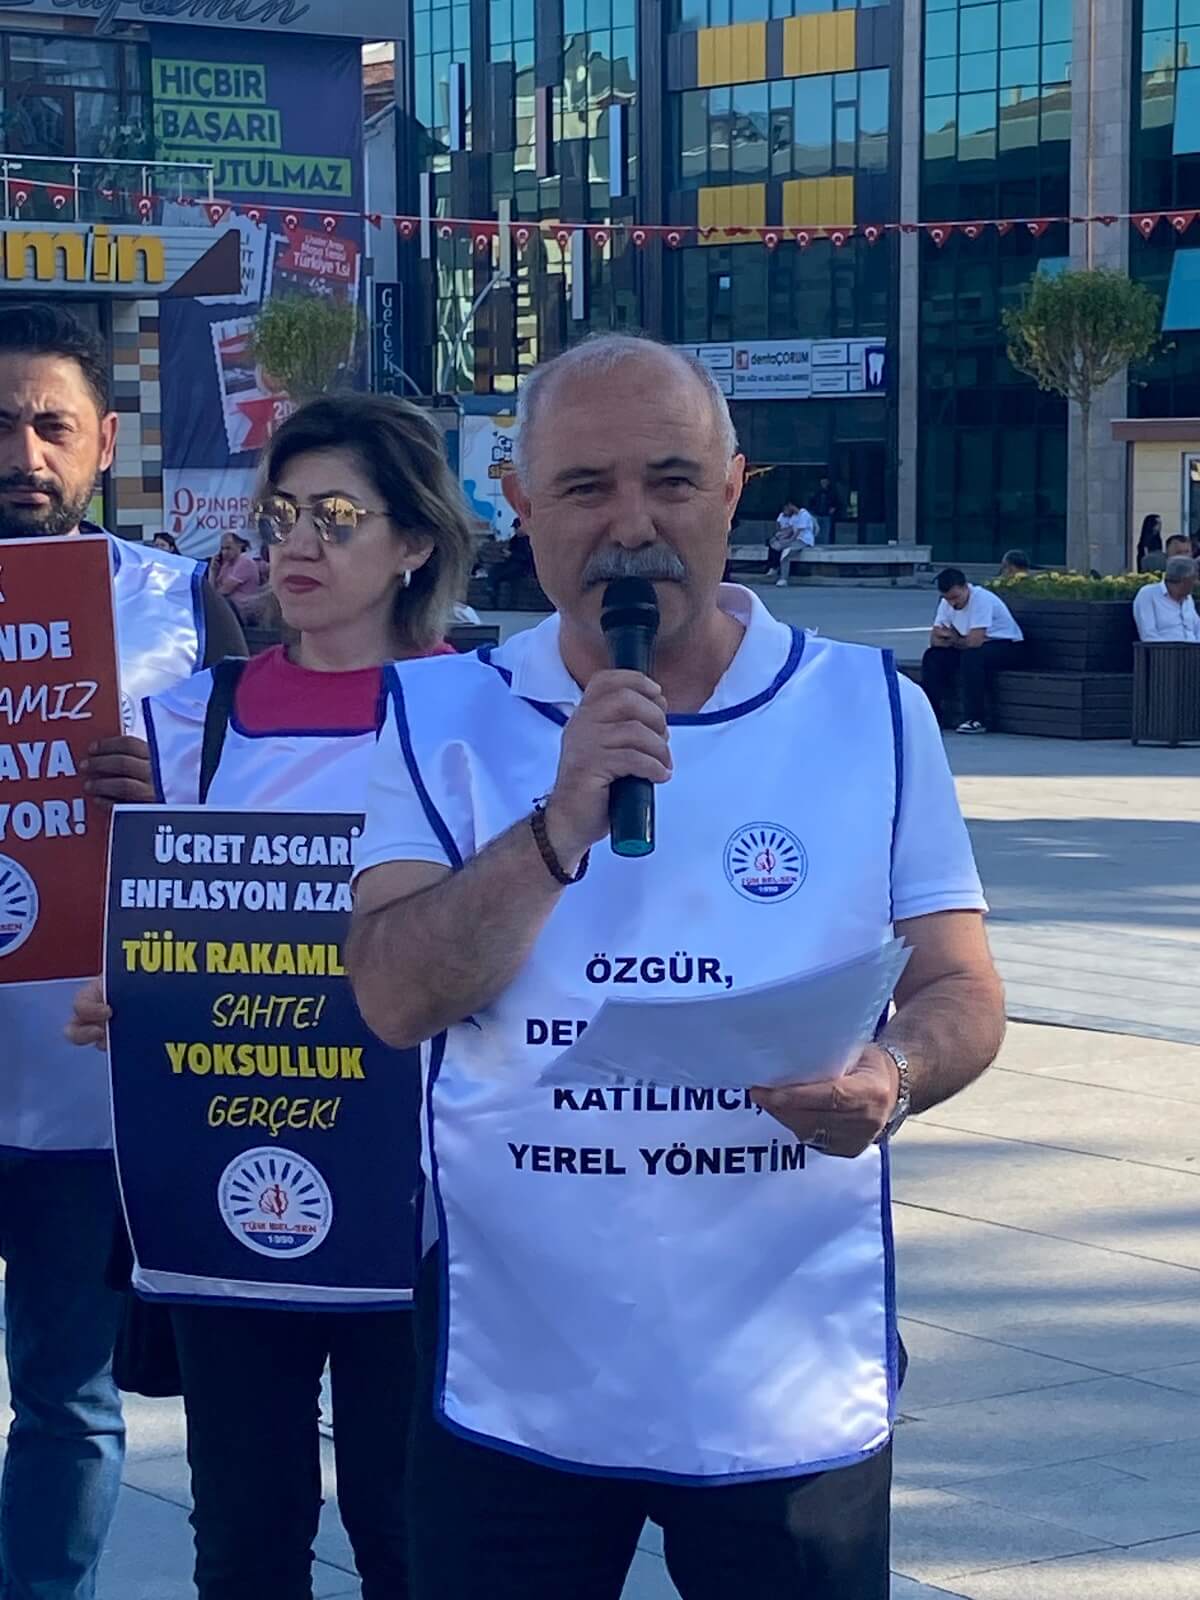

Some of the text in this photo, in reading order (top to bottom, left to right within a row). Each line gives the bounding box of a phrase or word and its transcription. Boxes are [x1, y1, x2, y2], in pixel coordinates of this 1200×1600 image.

[162, 110, 276, 143] BAŞARI
[0, 224, 166, 283] min
[0, 621, 72, 662] NDE
[0, 681, 98, 726] AMIZ
[0, 740, 77, 780] AYA
[155, 825, 246, 865] ÜCRET
[120, 878, 354, 912] ENFLASYON AZA
[122, 930, 347, 976] TÜİK RAKAML
[585, 951, 734, 989] ÖZGÜR,
[211, 993, 326, 1029] SAHTE!
[165, 1042, 366, 1079] YOKSULLUK
[207, 1096, 341, 1137] GERÇEK!
[507, 1138, 806, 1176] YEREL YÖNETİM
